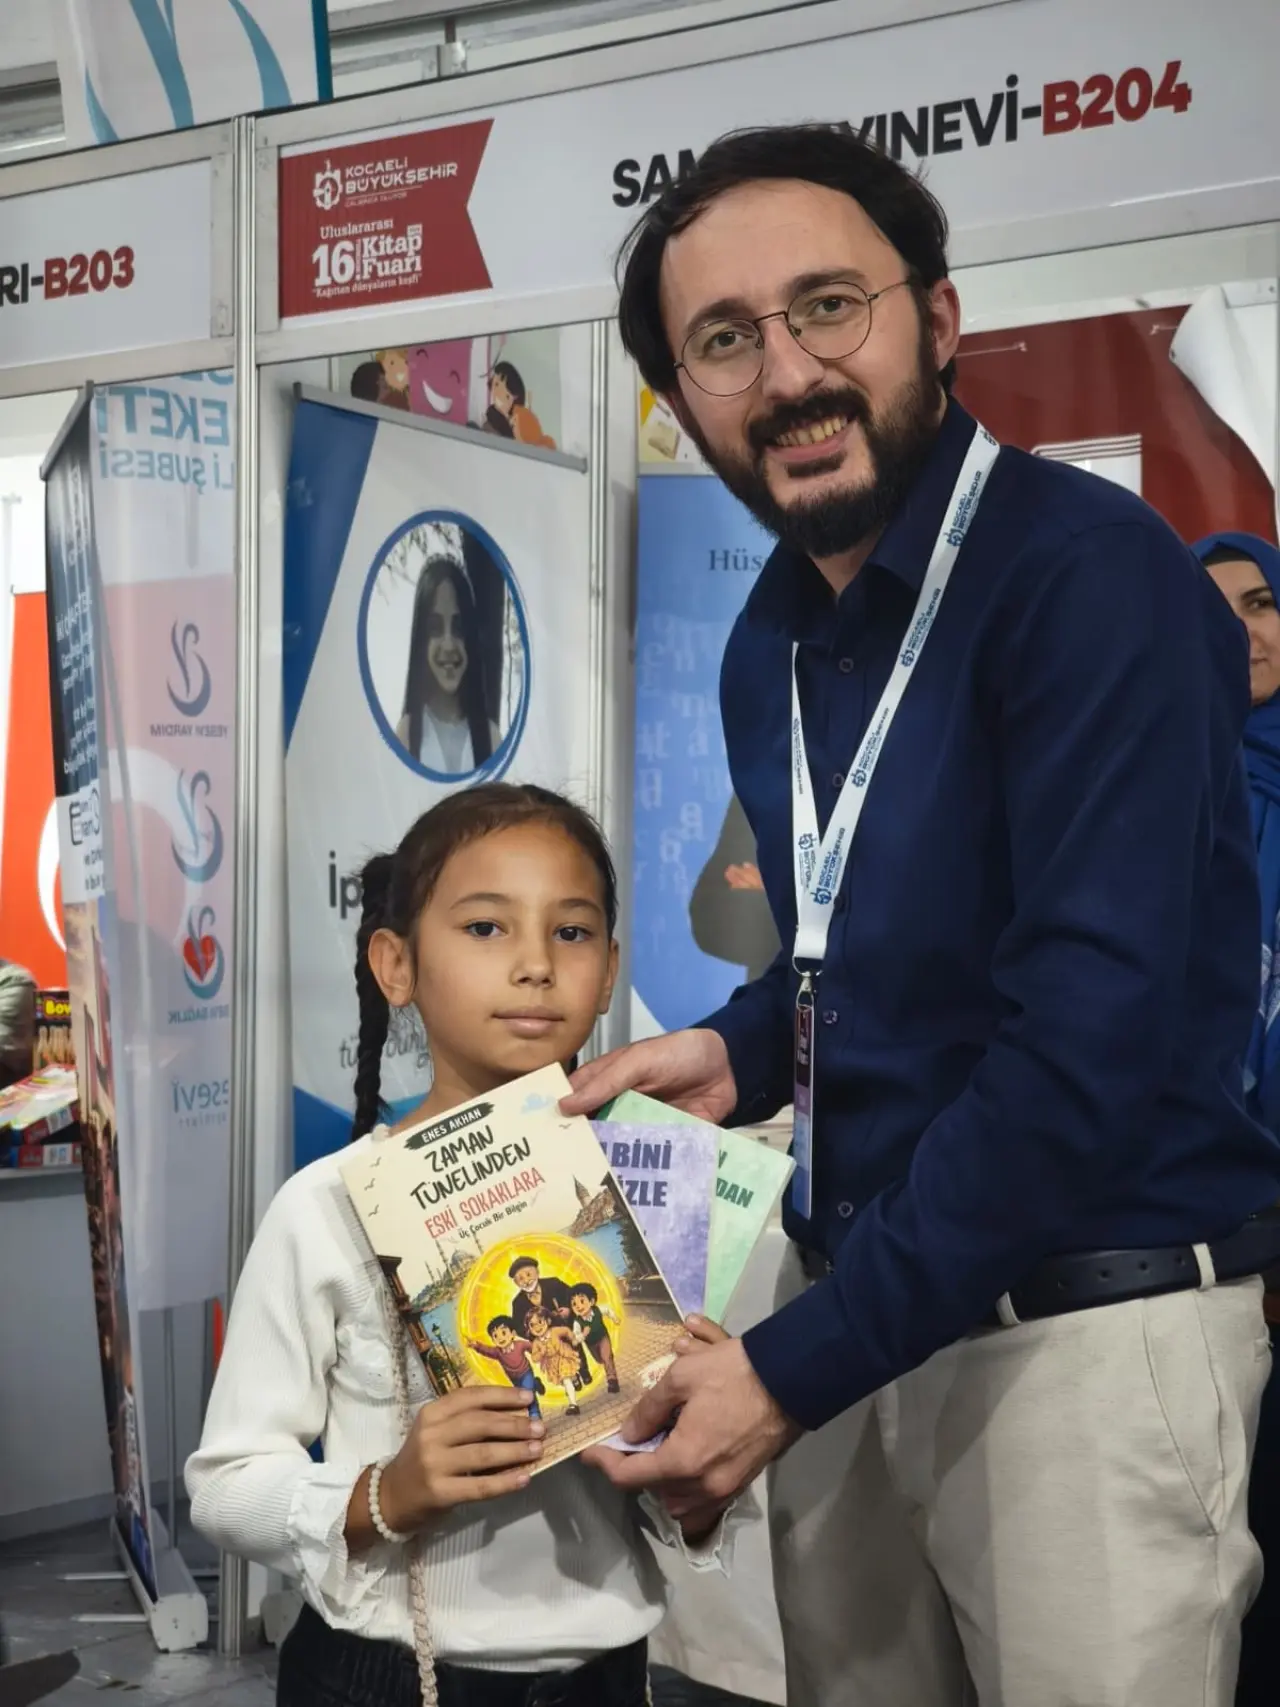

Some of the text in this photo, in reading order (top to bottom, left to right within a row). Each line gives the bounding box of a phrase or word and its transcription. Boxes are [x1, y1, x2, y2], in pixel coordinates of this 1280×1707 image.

[345, 156, 408, 178] KOCAELİ
[345, 162, 458, 194] BÜYÜKŞEHİR
[320, 219, 394, 239] Uluslararası
[362, 233, 422, 259] Kitap
[361, 255, 422, 279] Fuarı
[422, 1108, 482, 1143] ENES AKHAN
[424, 1124, 494, 1173] ZAMAN
[601, 1138, 672, 1170] BİNİ
[410, 1136, 531, 1210] TÜNELİNDEN
[424, 1167, 546, 1239] ESKİ SOKAKLARA
[492, 1210, 505, 1223] Bir
[505, 1200, 528, 1215] Bilgin
